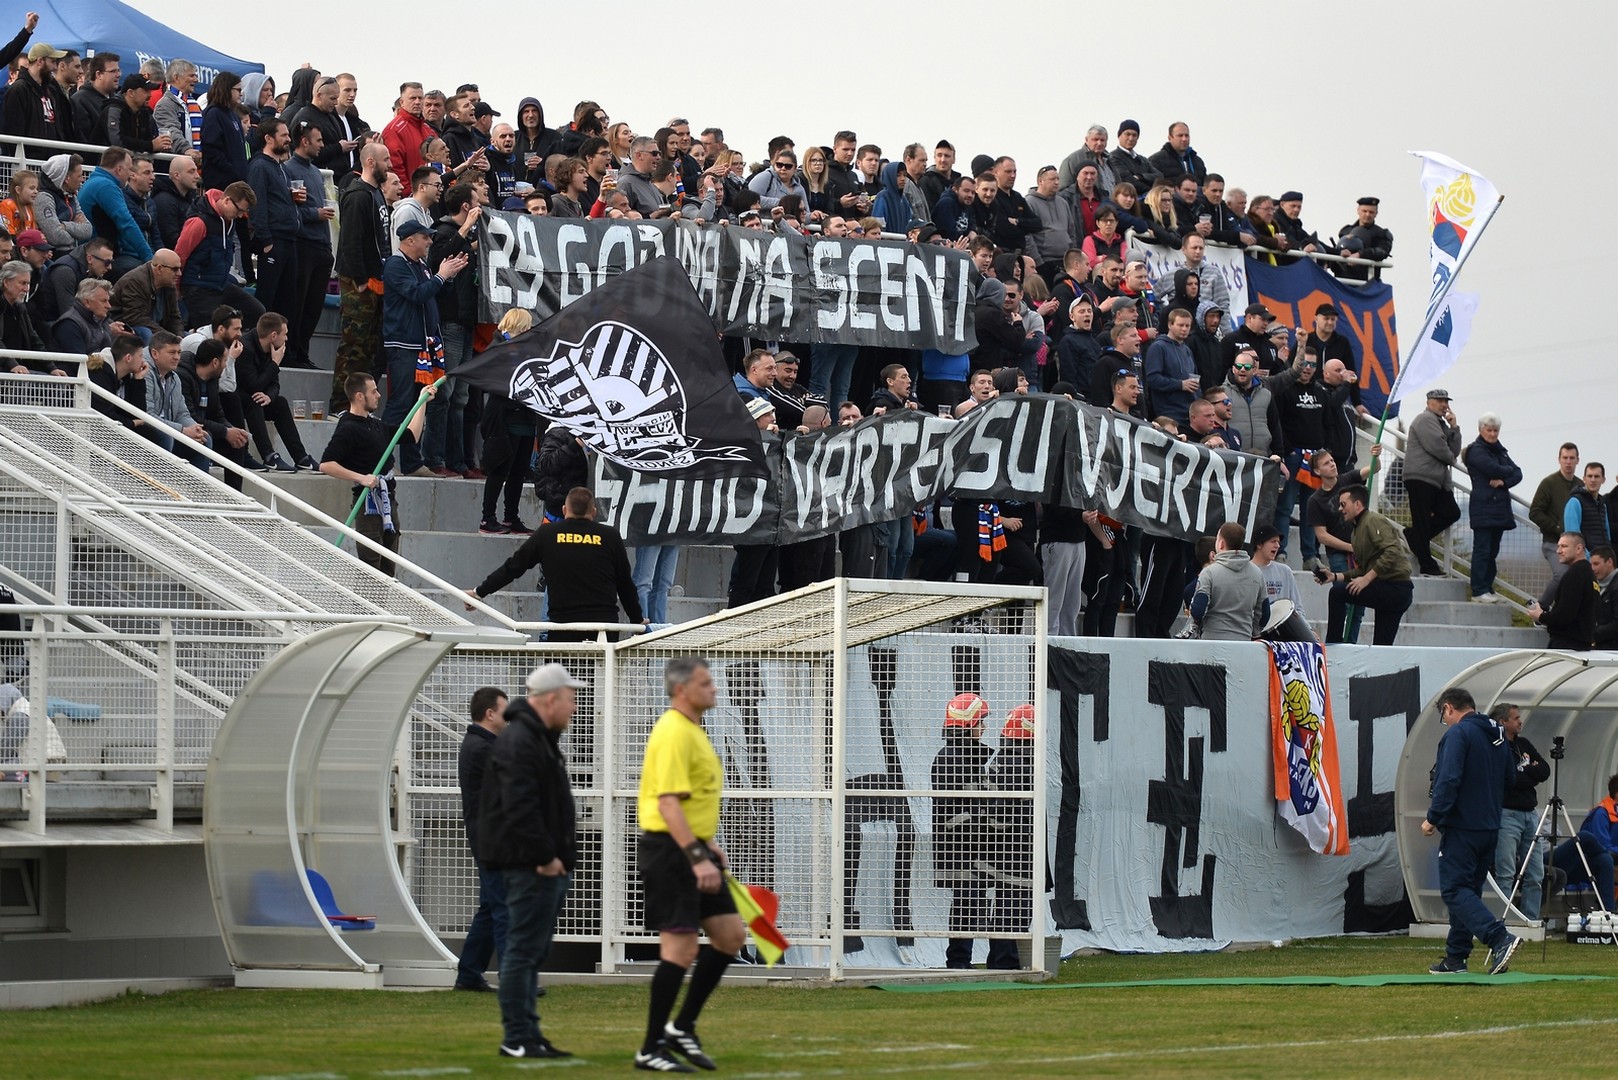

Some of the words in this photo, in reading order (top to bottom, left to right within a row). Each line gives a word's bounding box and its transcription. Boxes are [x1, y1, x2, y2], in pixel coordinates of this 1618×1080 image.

[488, 214, 545, 310] 29
[727, 236, 794, 328] NA
[813, 241, 969, 341] SCENI
[1077, 408, 1265, 544] VJERNI
[556, 533, 602, 545] REDAR
[1576, 936, 1600, 944] erima
